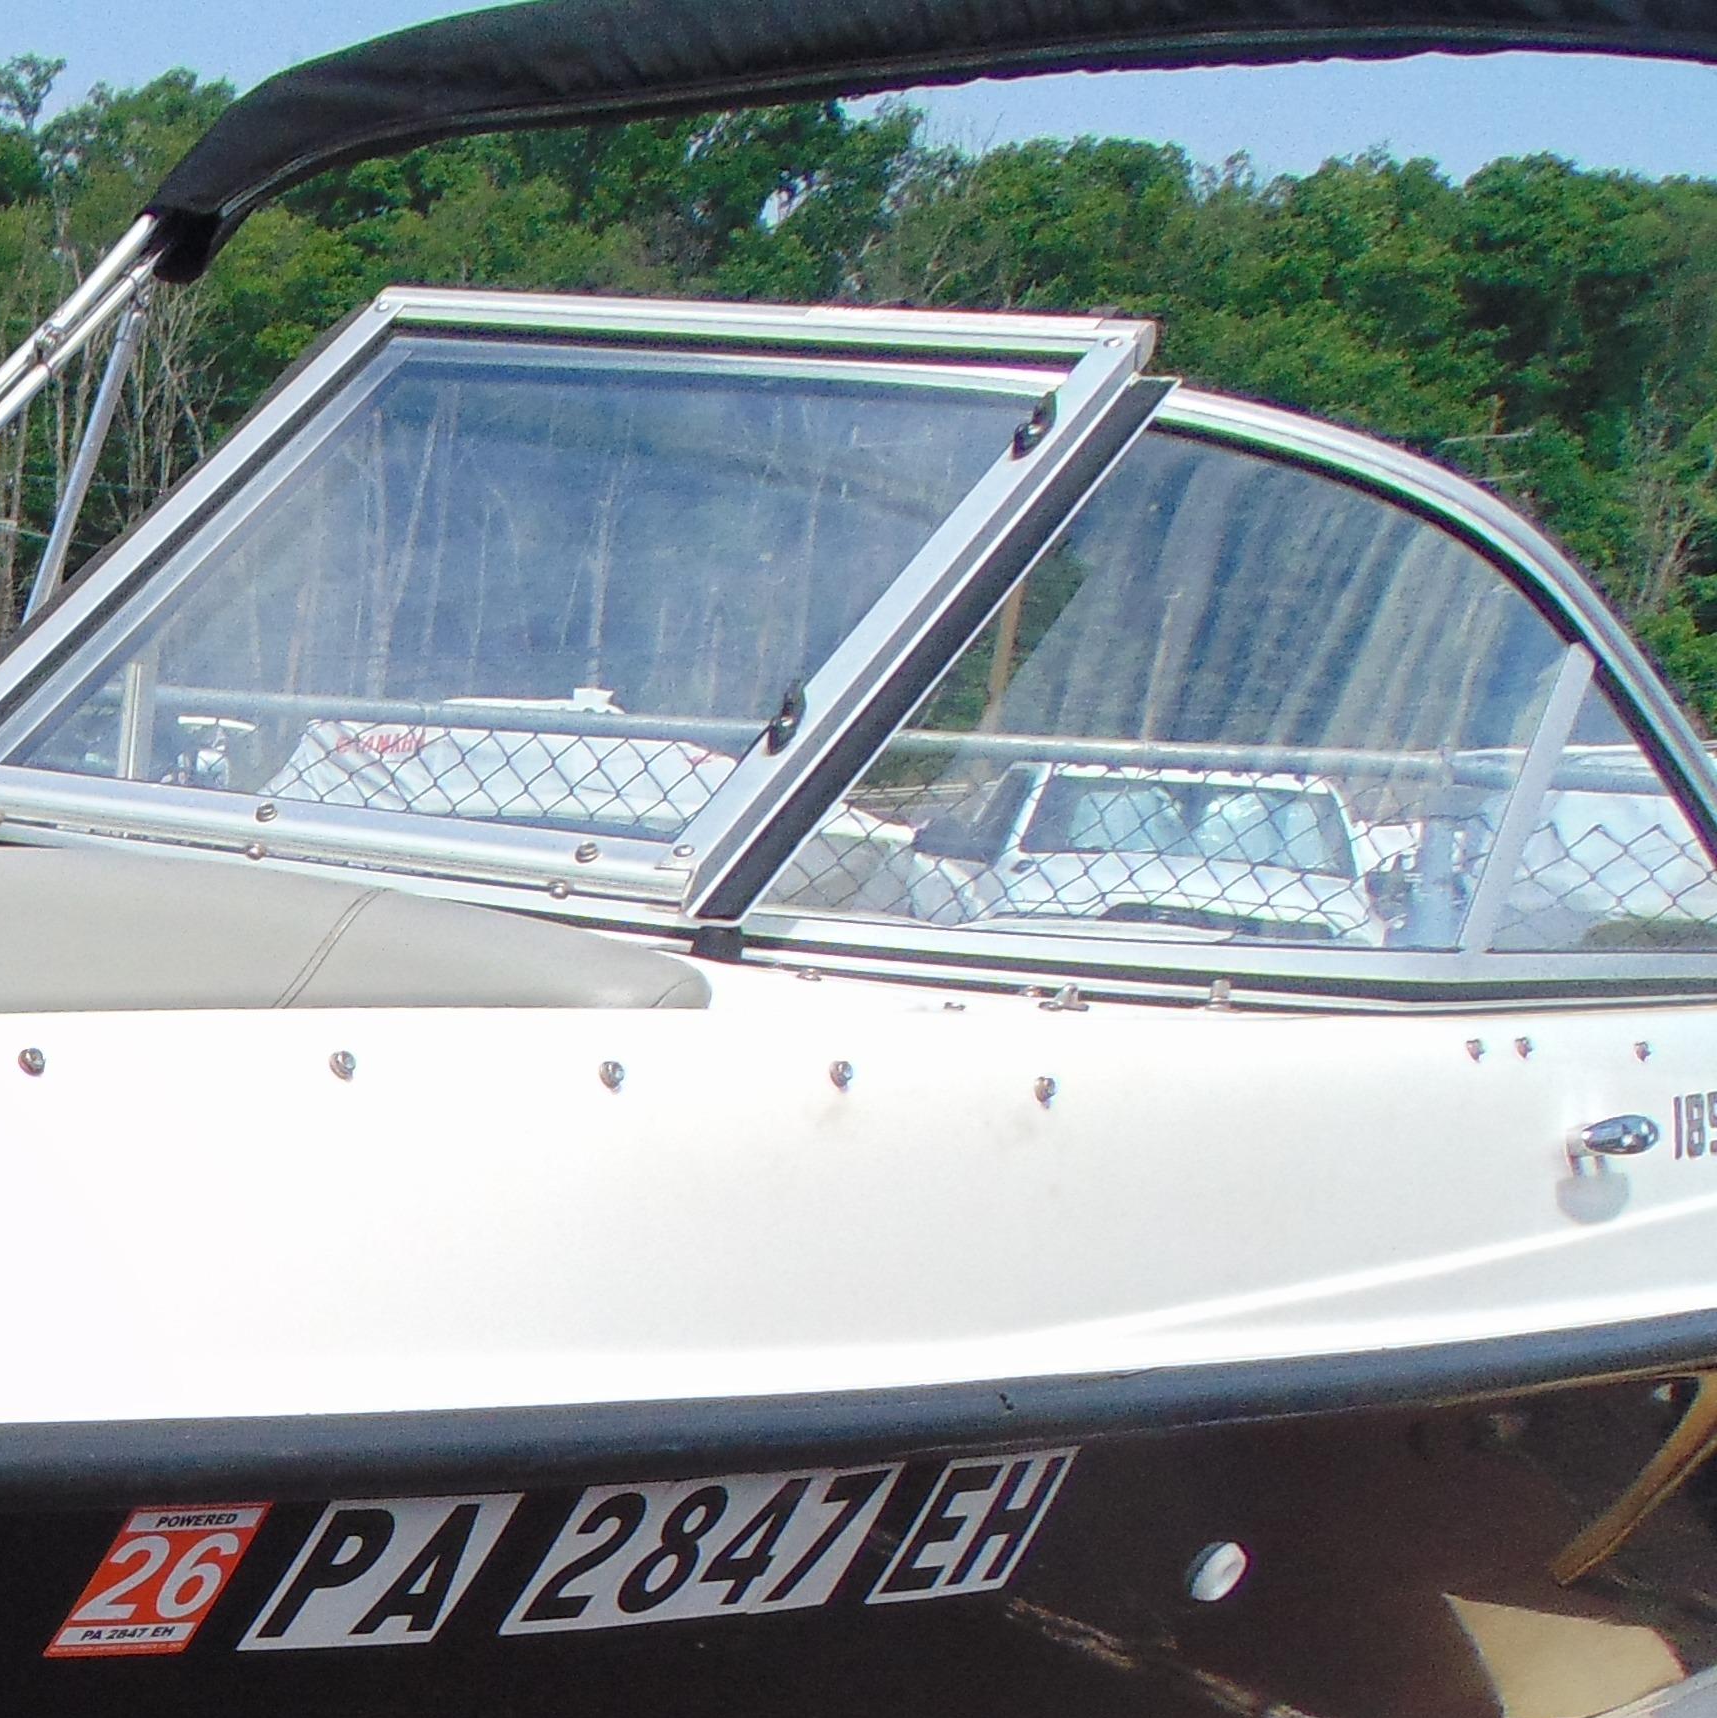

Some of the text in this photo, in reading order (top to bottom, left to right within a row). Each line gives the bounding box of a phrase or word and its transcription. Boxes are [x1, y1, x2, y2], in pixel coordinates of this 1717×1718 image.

[155, 1513, 238, 1529] POWERED
[255, 1457, 1067, 1639] PA 2847 EH
[70, 1532, 240, 1621] 26
[80, 1626, 176, 1641] PA 2847 EH
